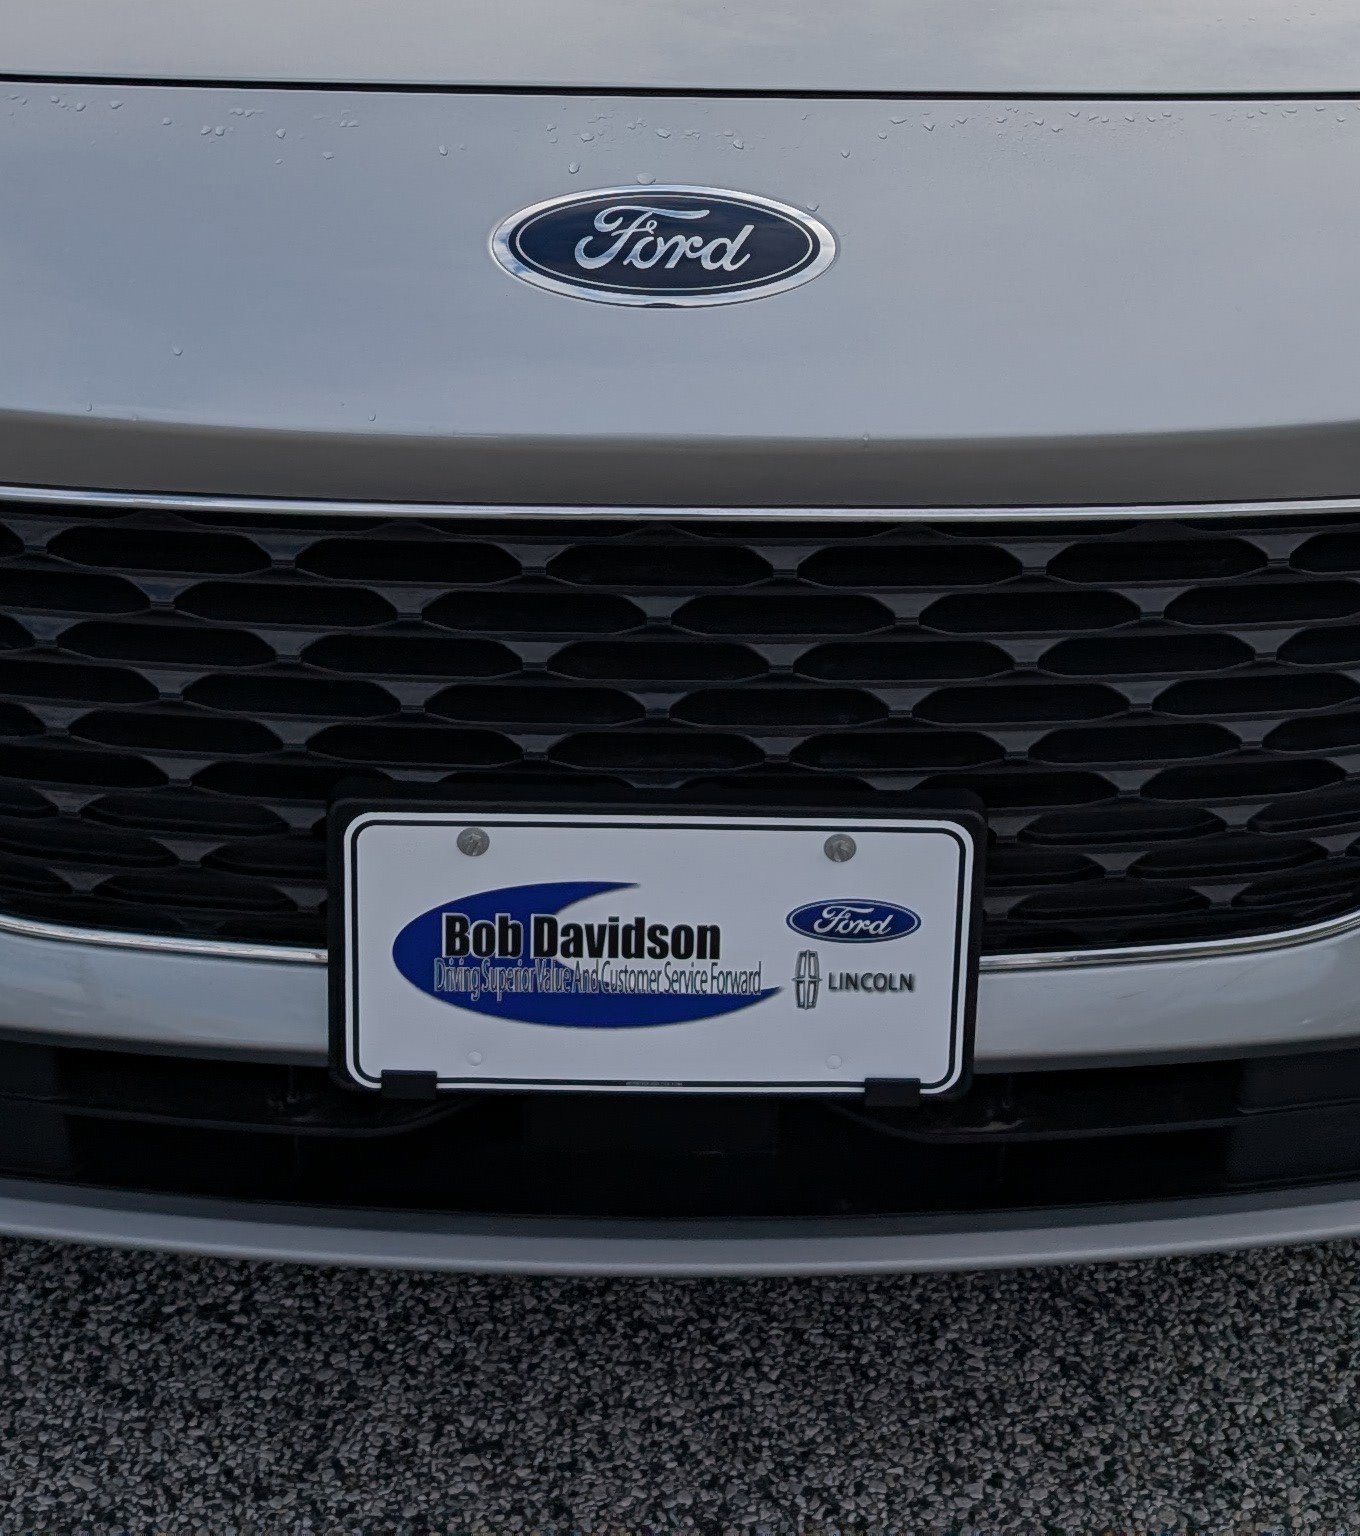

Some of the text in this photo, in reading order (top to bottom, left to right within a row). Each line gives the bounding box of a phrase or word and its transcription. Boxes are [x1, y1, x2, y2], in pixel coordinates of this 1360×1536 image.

[574, 204, 756, 272] Ford
[443, 914, 721, 960] Bob Davidson
[812, 904, 892, 936] Ford
[434, 957, 762, 1002] Driving Superior Value And Customer Service Forward
[827, 971, 916, 994] LINCOLN
